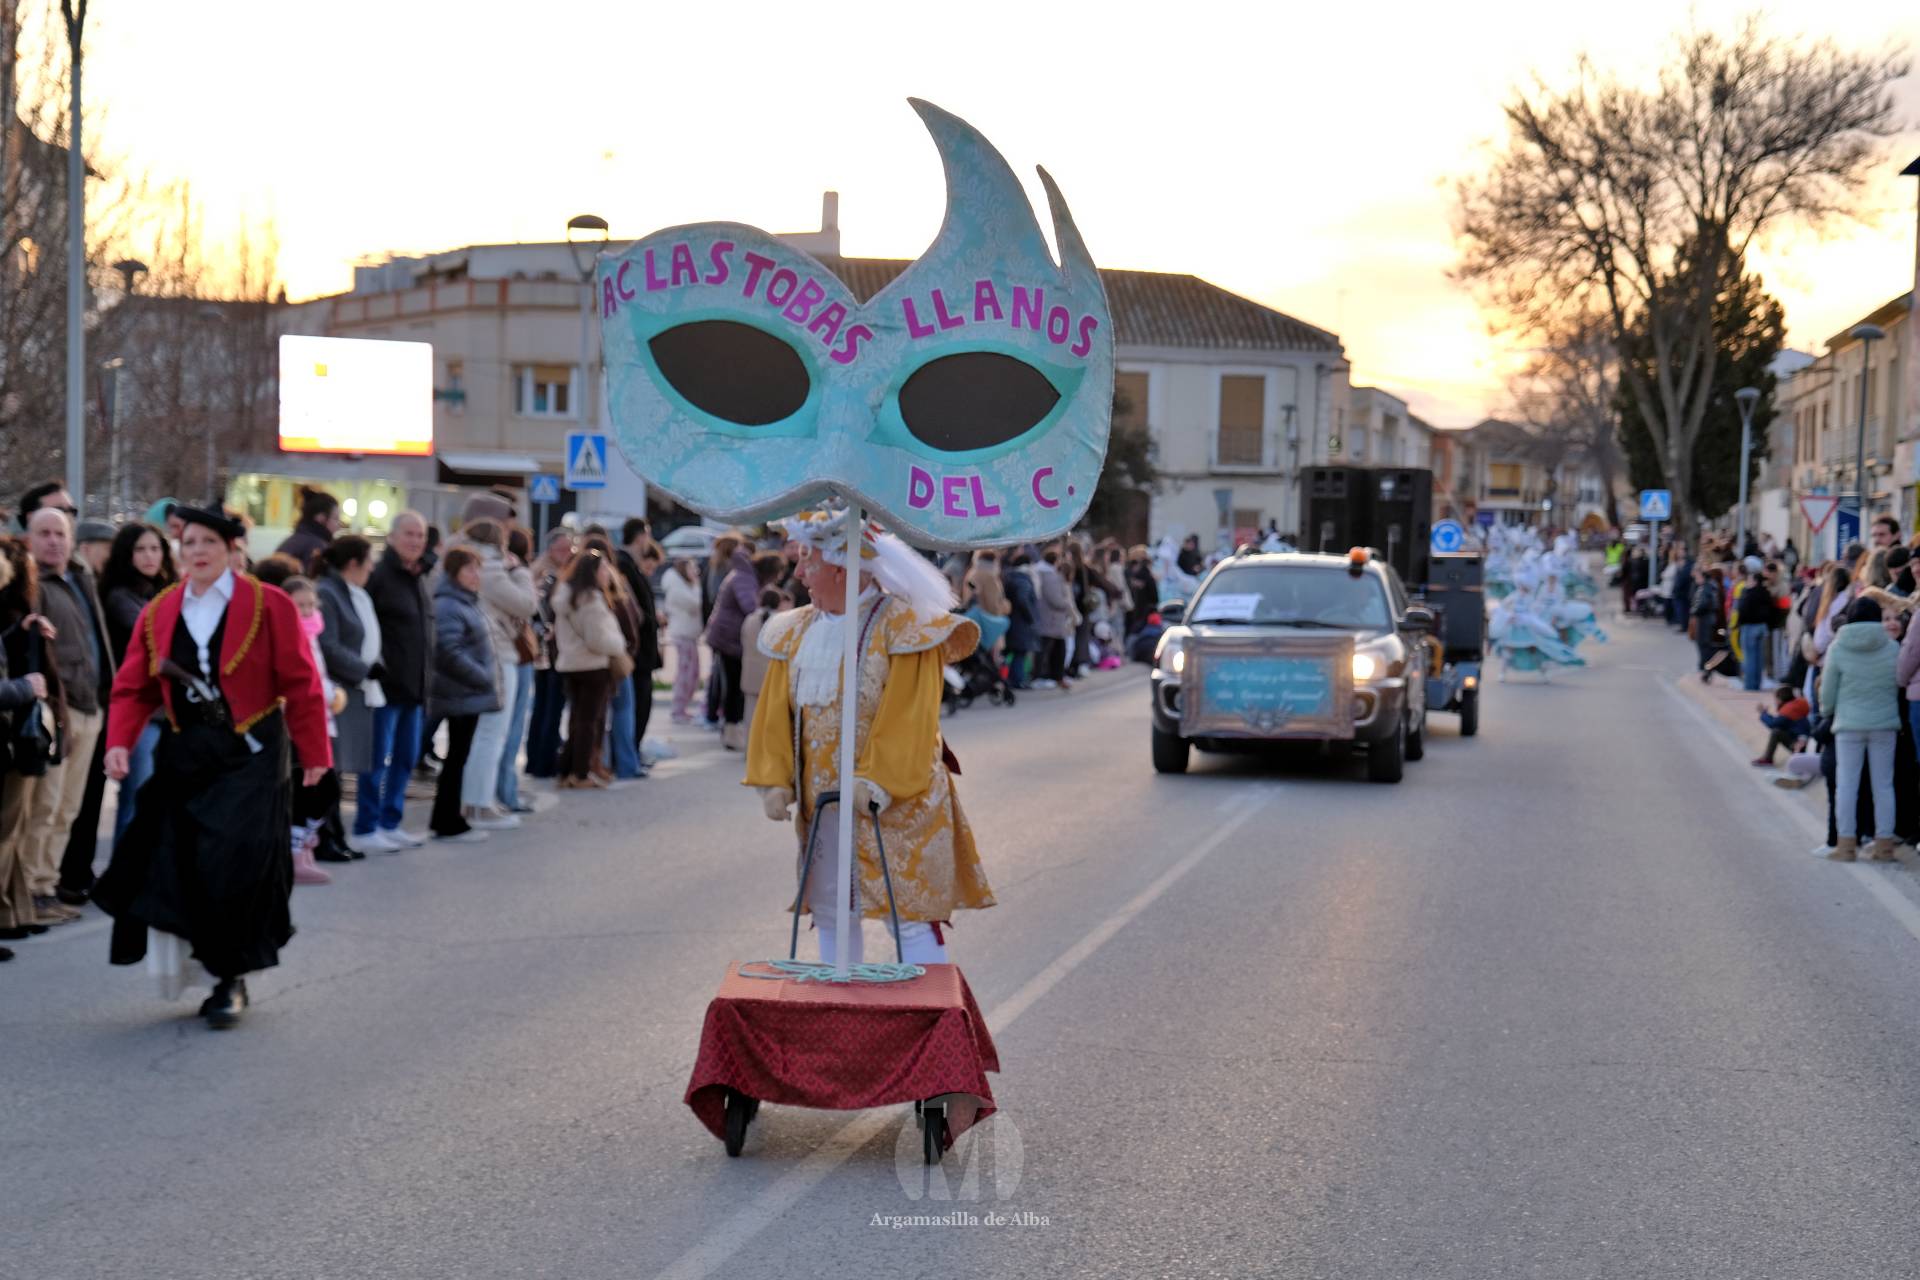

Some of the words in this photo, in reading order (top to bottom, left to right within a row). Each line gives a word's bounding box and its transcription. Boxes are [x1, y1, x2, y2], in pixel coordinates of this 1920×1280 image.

[603, 261, 635, 319] AC
[645, 241, 734, 291] LAS
[743, 251, 873, 364] TOBAS
[902, 279, 1098, 357] LLANOS
[908, 466, 1000, 517] DEL
[1032, 467, 1074, 508] C.
